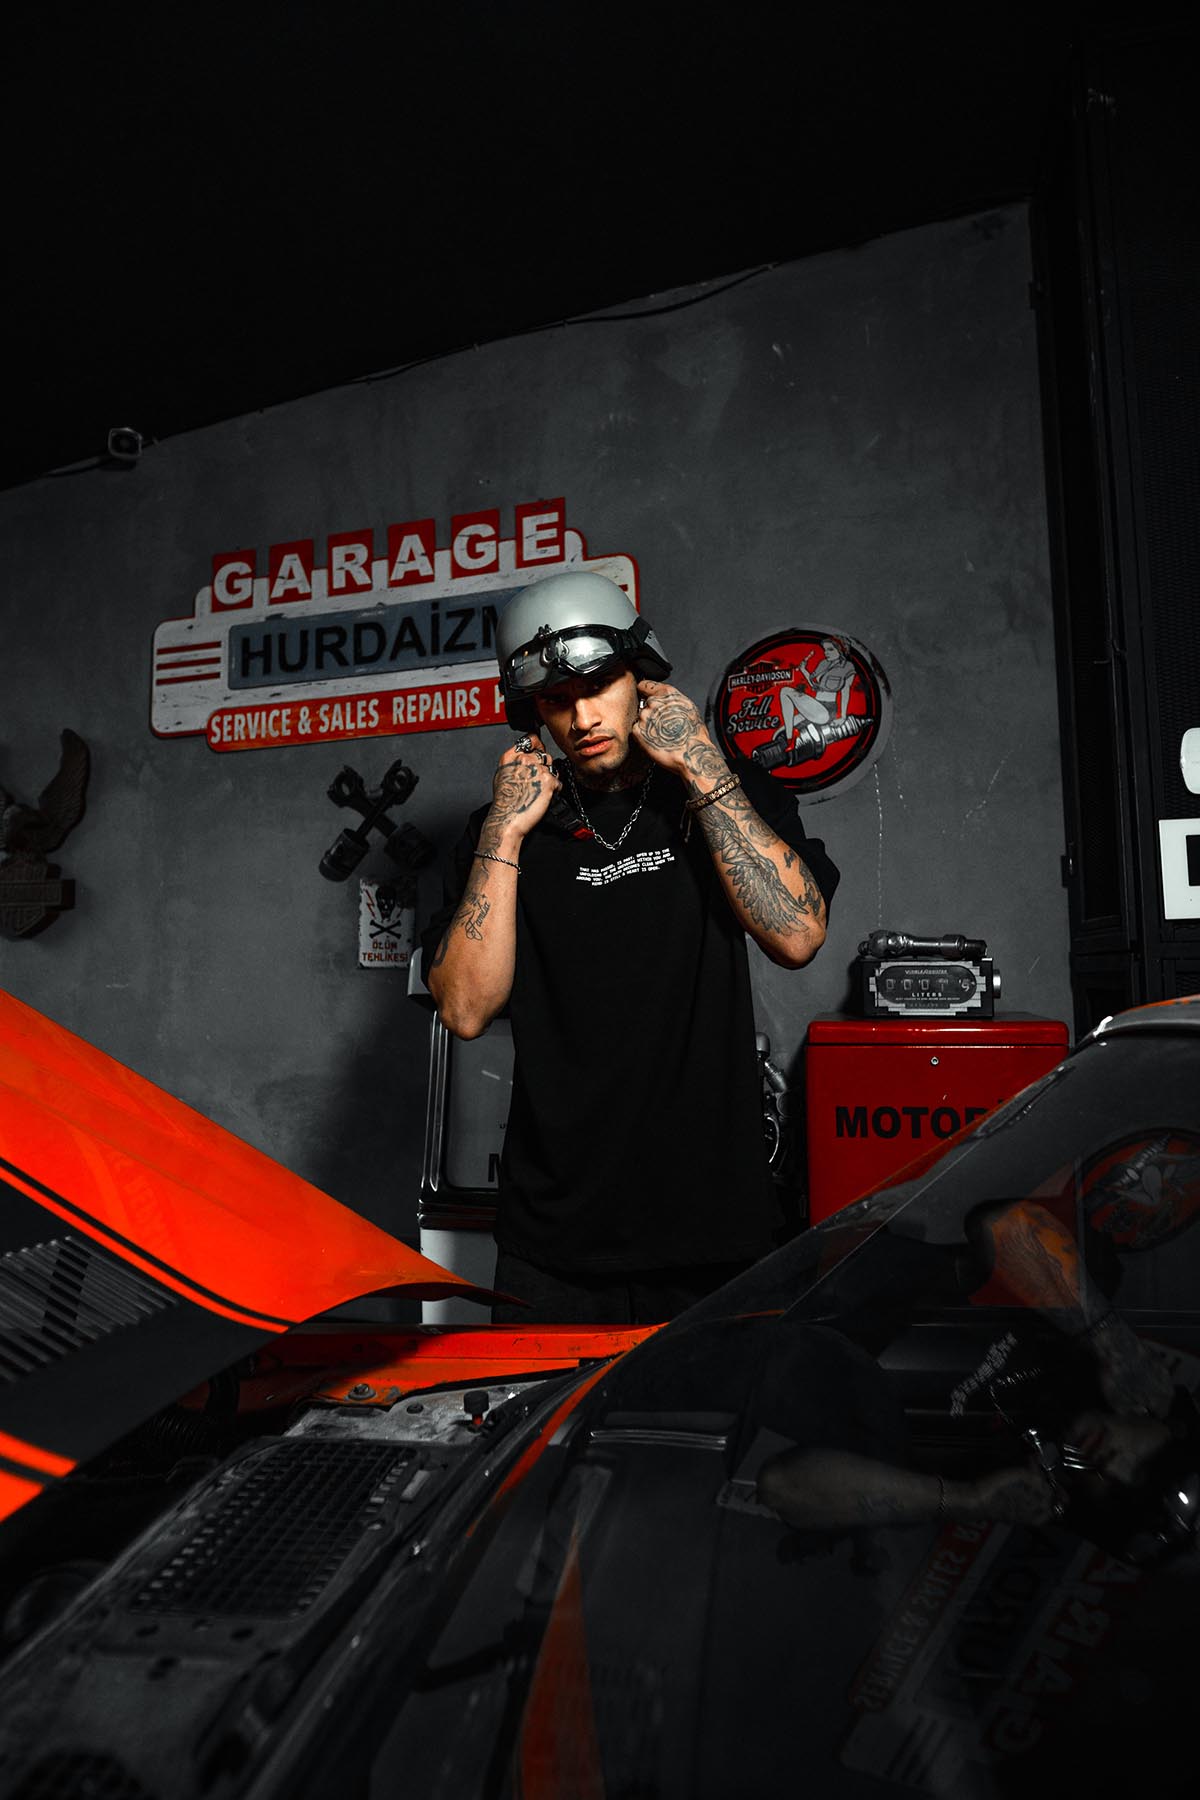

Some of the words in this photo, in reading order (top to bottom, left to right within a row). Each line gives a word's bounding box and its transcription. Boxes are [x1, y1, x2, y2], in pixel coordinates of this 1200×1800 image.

[213, 512, 560, 605] GARAGE
[731, 671, 791, 687] HARLEY-DAVIDSON
[210, 705, 290, 744] SERVICE
[297, 706, 316, 733] &
[319, 699, 379, 731] SALES
[392, 687, 481, 723] REPAIRS
[738, 696, 773, 718] Full
[728, 714, 780, 734] Service
